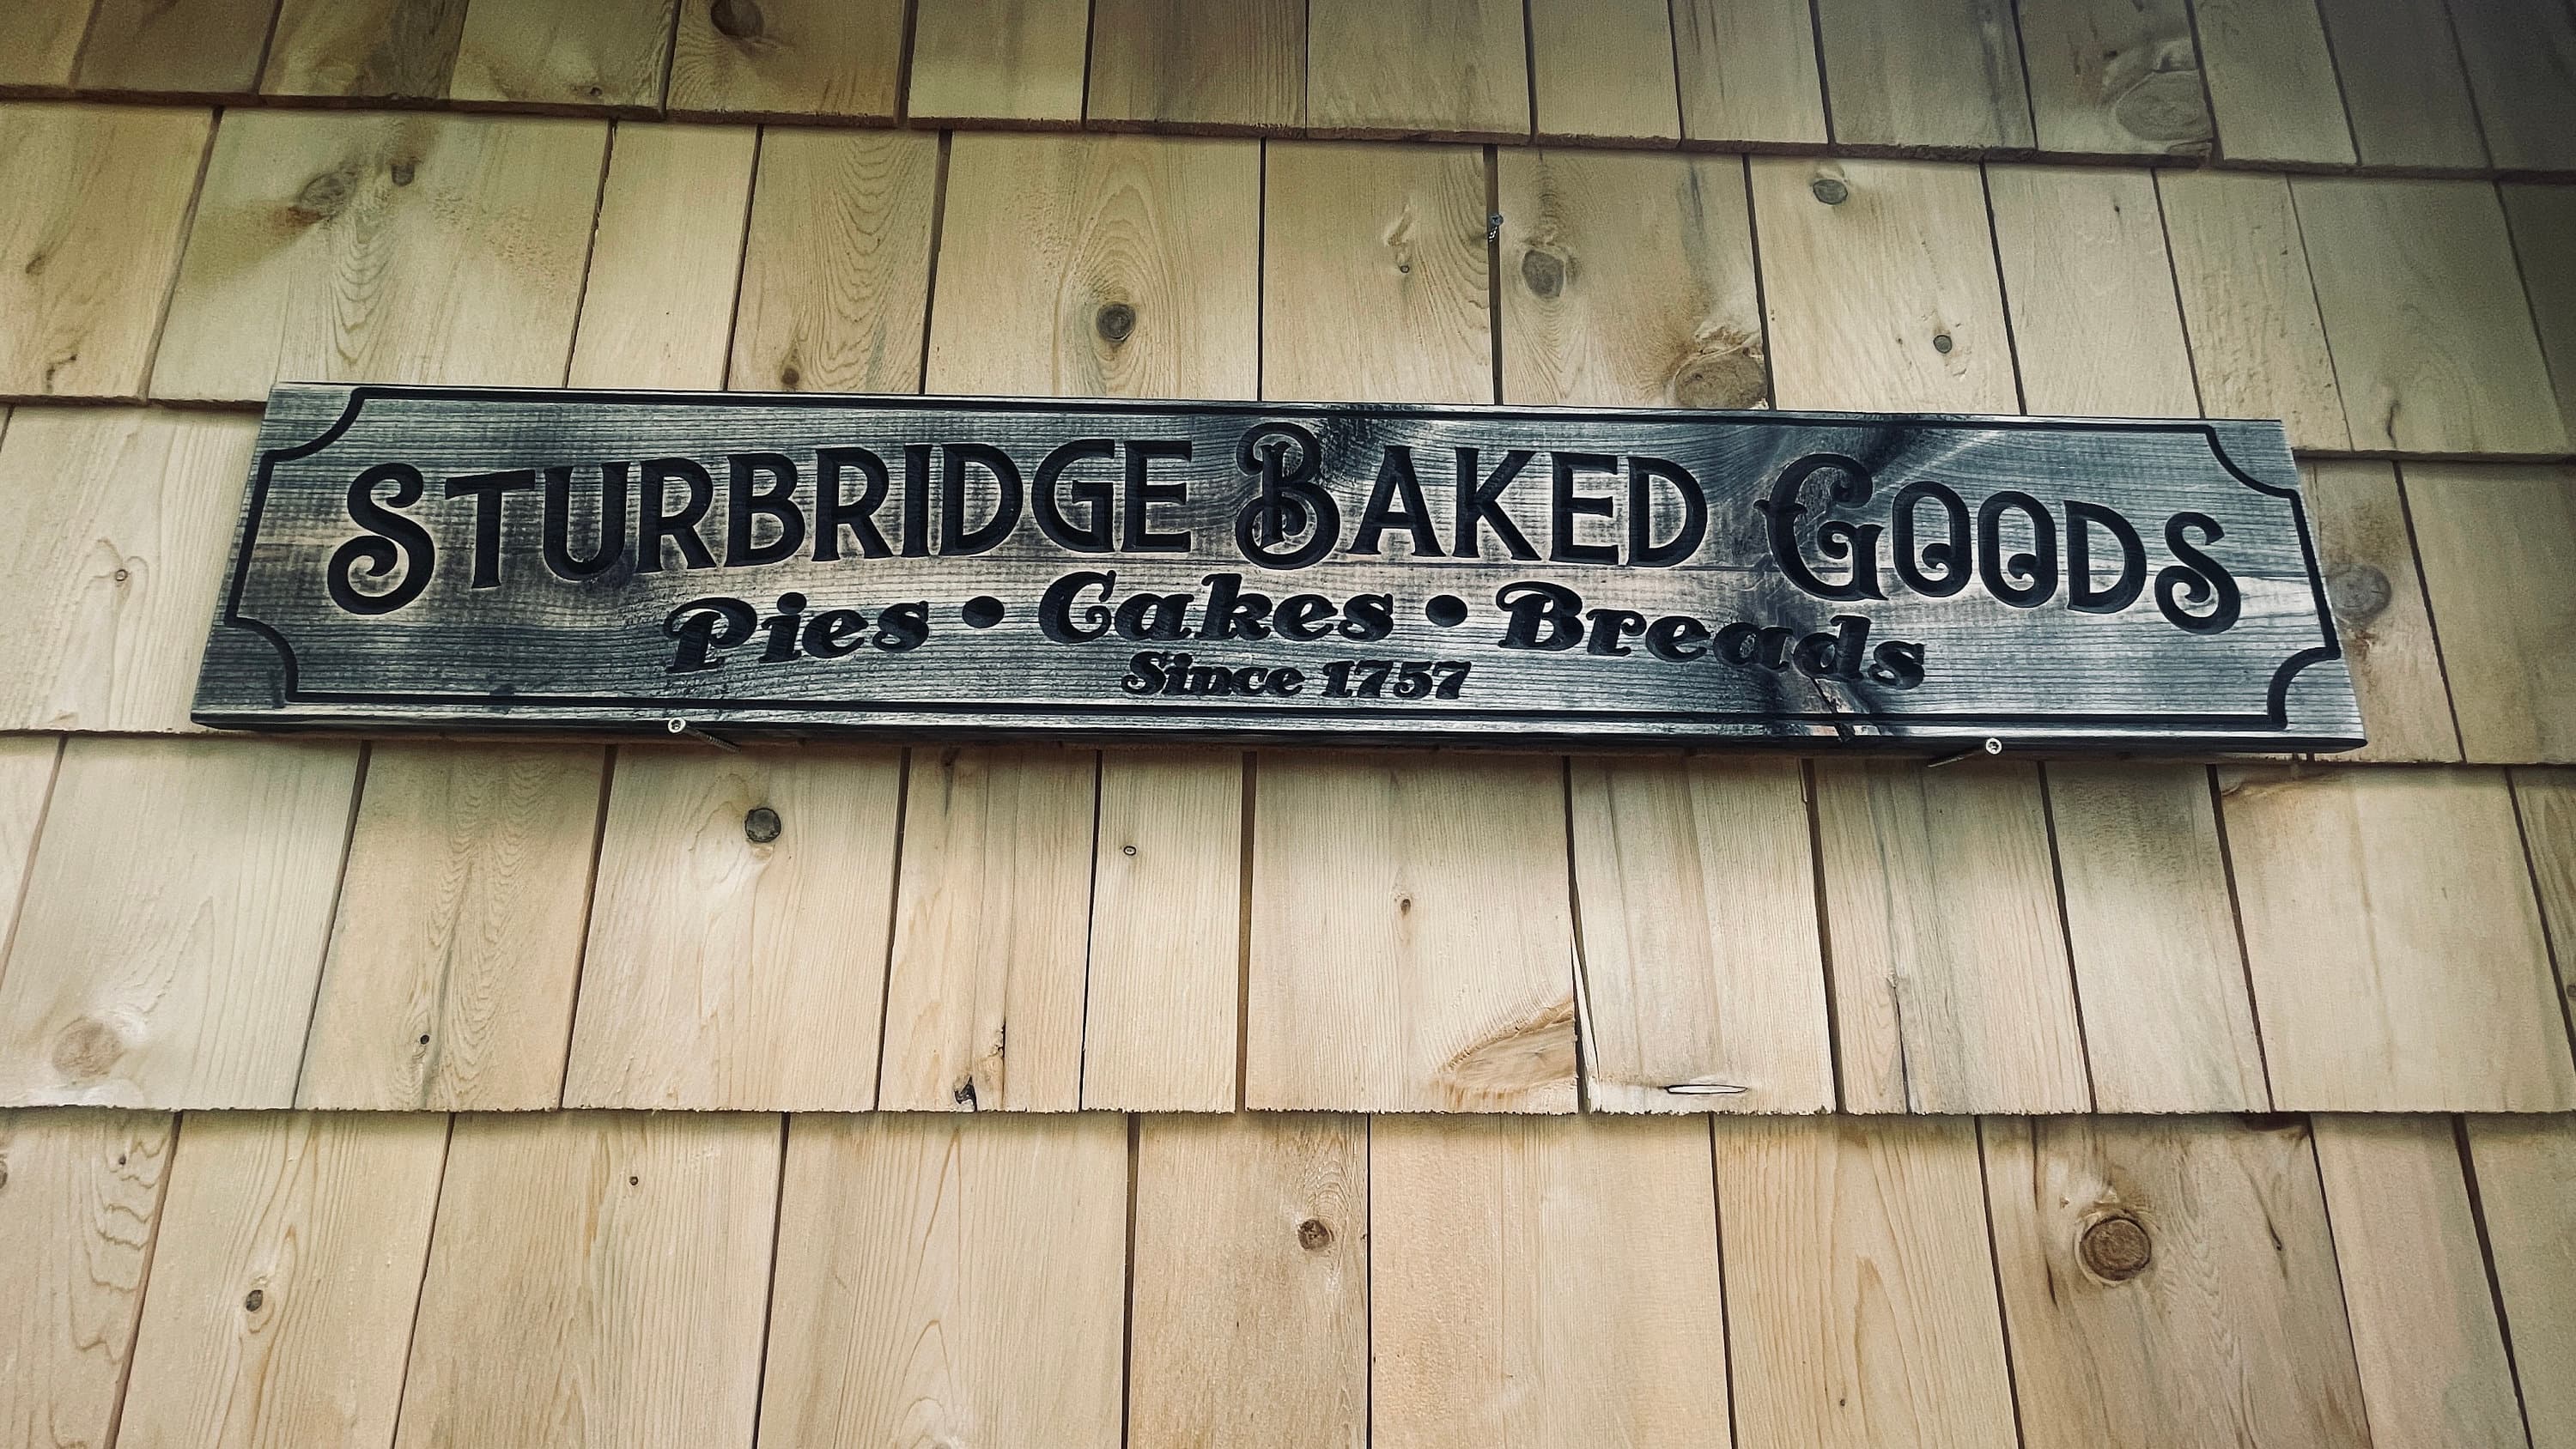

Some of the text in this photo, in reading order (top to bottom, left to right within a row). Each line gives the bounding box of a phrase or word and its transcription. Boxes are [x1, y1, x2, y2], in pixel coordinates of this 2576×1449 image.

[327, 421, 2242, 635] STURBRIDGE BAKED GOODS
[664, 571, 1925, 688] Pies Cakes Breads
[1121, 651, 1472, 700] Since 1757
